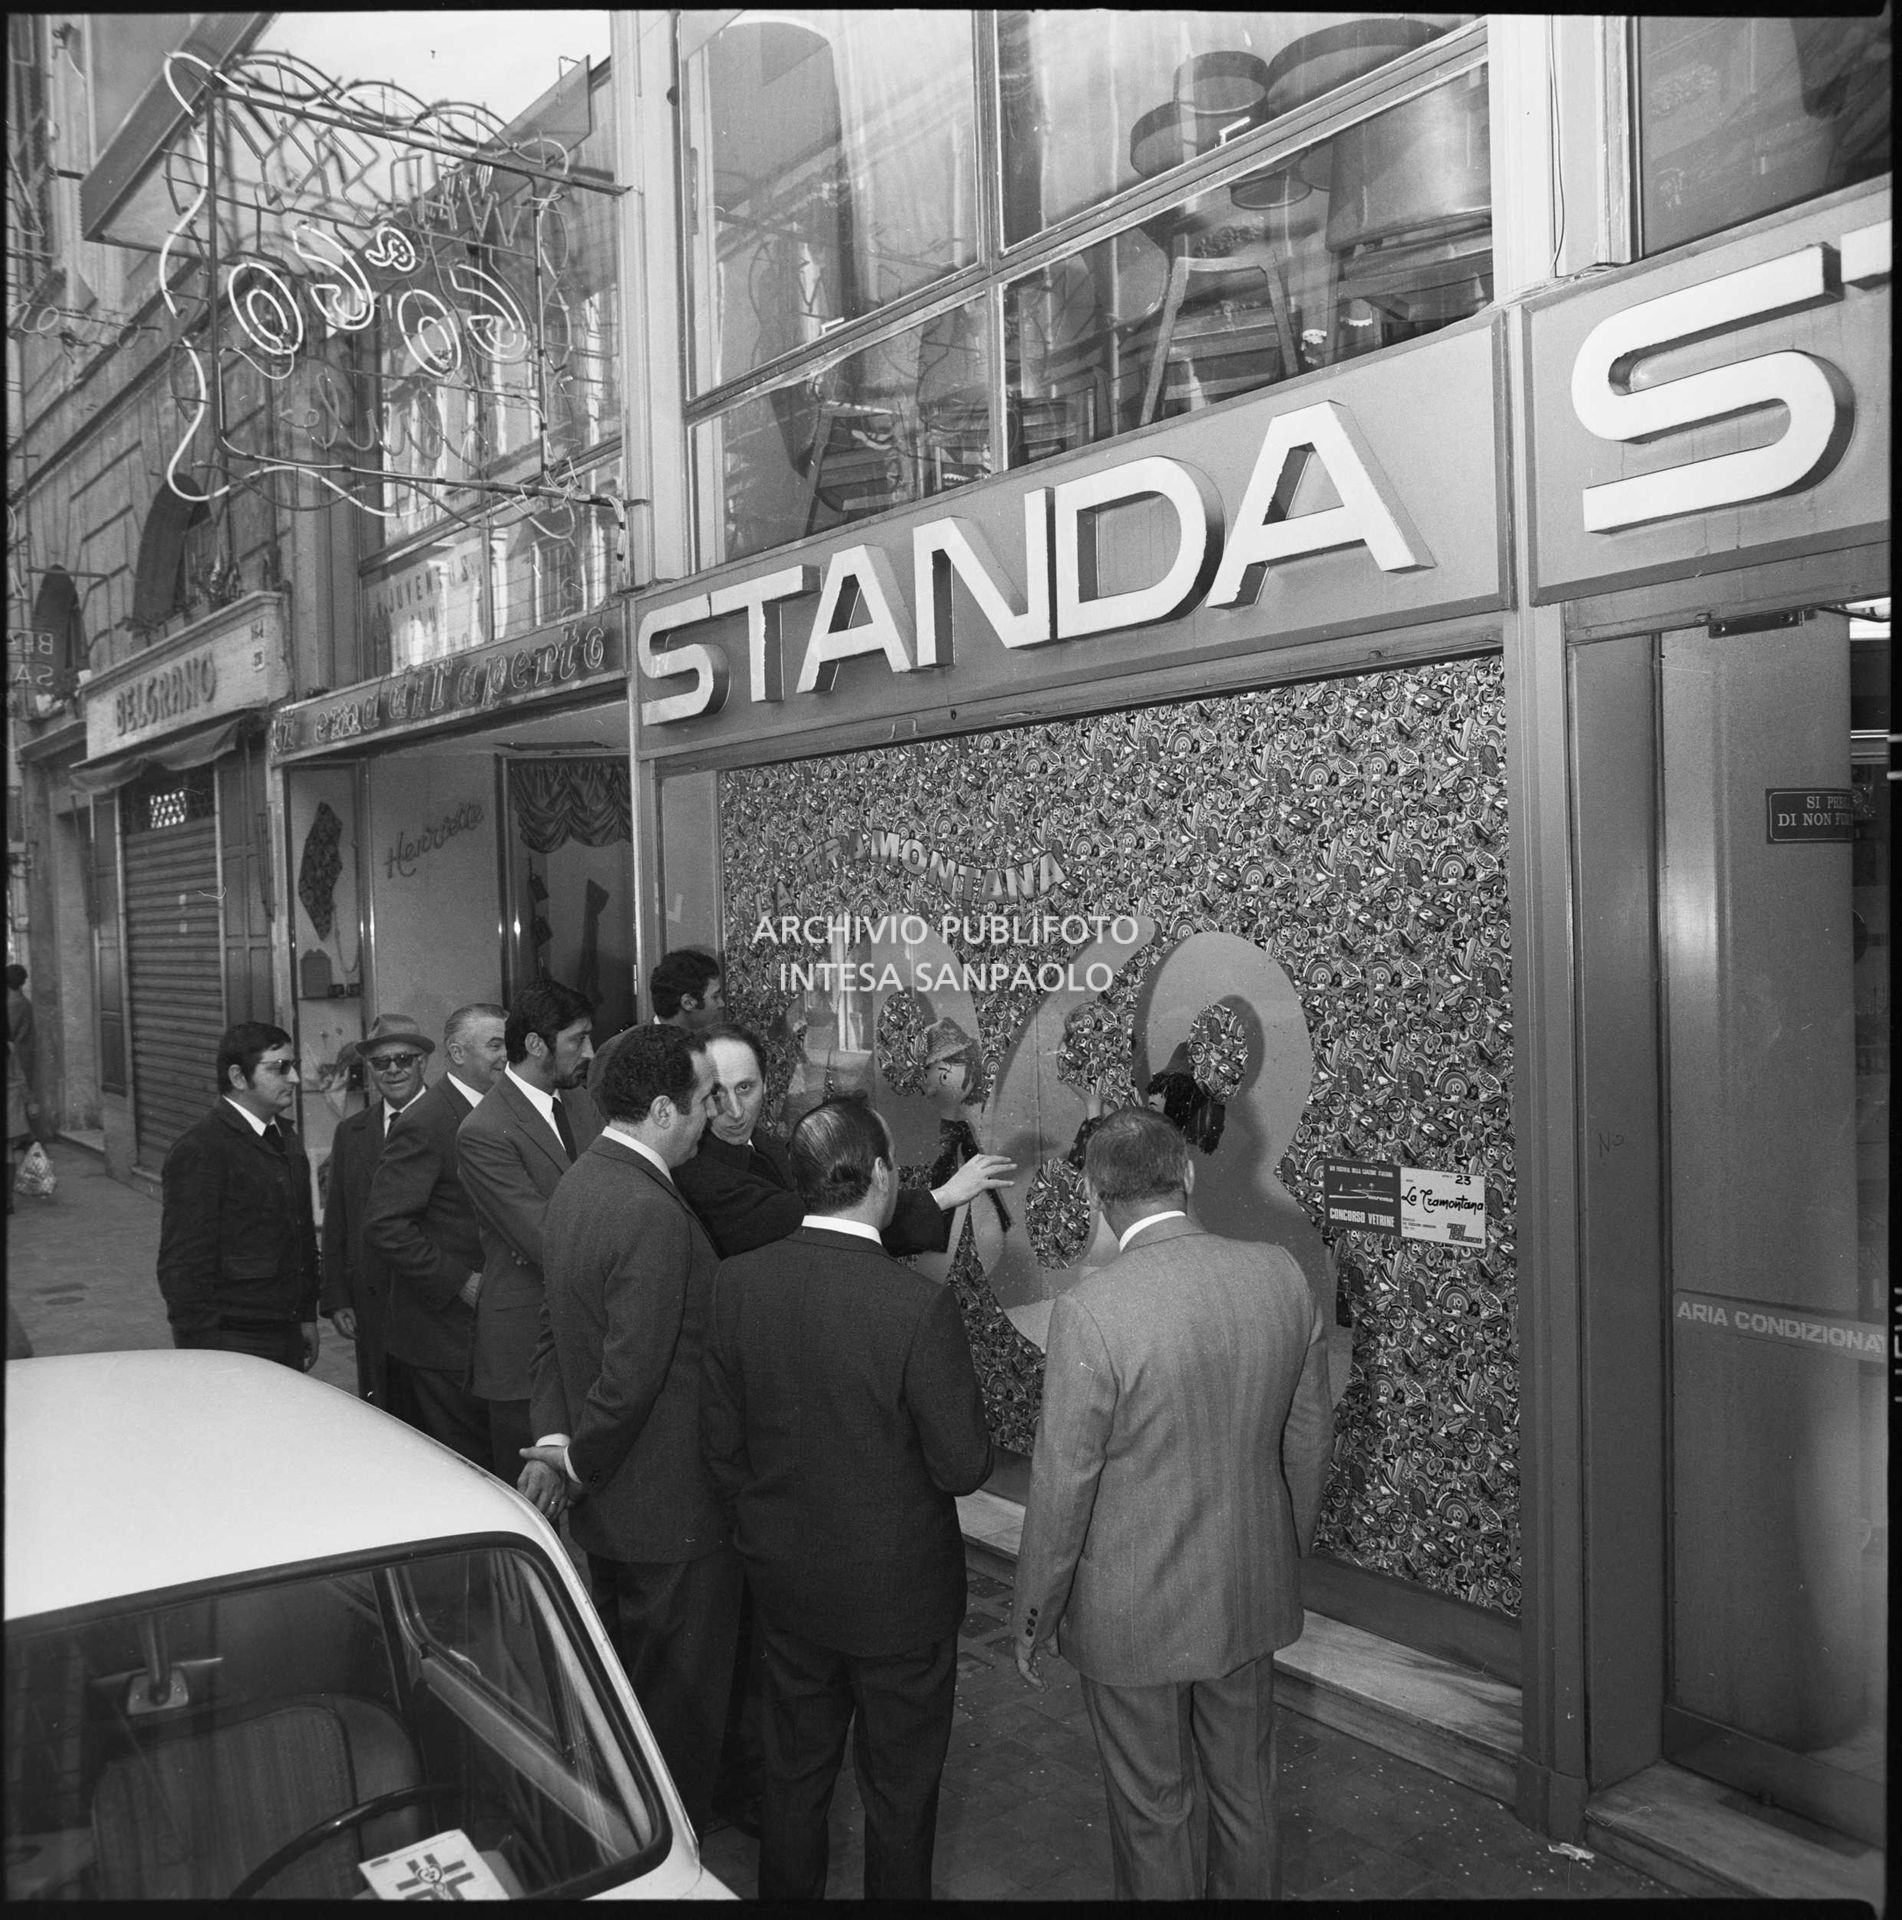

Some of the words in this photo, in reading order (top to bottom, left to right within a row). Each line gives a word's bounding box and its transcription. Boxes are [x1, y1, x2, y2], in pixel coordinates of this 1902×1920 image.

[639, 400, 1434, 727] STANDA
[116, 651, 216, 737] BELGRANO
[1806, 795, 1821, 809] SI
[1777, 813, 1797, 827] DI
[1802, 812, 1832, 826] NON
[802, 827, 1068, 902] TRAMONTANA
[1455, 1174, 1472, 1186] 23
[1401, 1186, 1417, 1206] La
[1329, 1207, 1366, 1224] CONCORSO
[1367, 1212, 1396, 1228] VETRINE
[1676, 1301, 1729, 1327] ARIA
